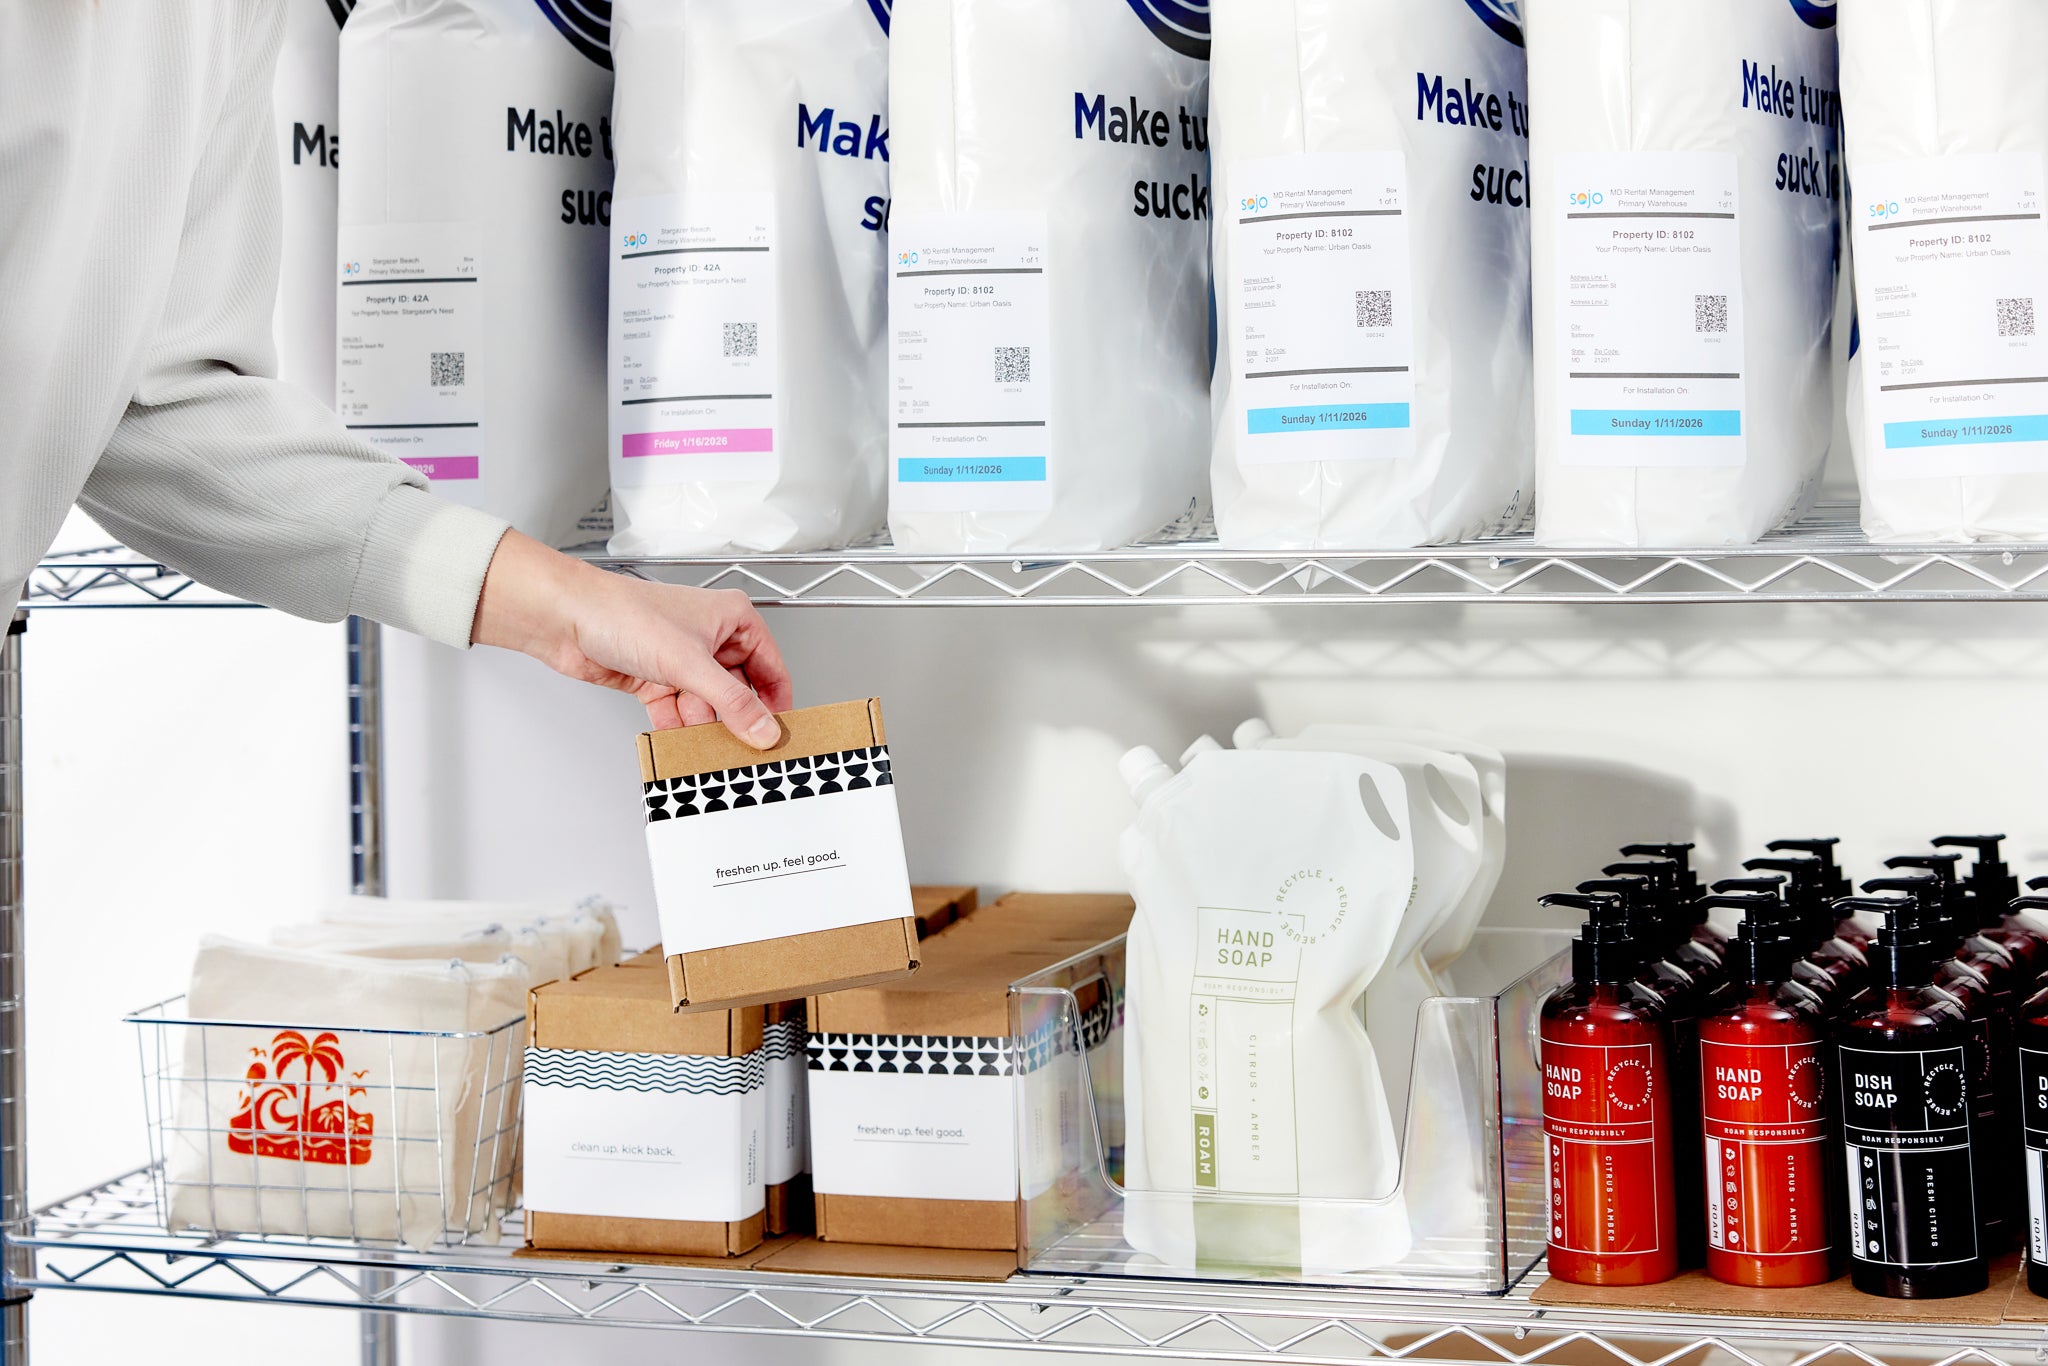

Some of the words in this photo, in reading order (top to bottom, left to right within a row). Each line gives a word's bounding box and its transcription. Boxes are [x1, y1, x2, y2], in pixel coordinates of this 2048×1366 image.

[1743, 59, 1794, 119] Make
[1417, 72, 1502, 131] Make
[1074, 92, 1169, 146] Make
[508, 107, 592, 155] Make
[1776, 147, 1821, 197] suck
[1134, 174, 1207, 220] suck
[1307, 188, 1352, 196] Management
[1570, 189, 1603, 208] sojo
[1650, 189, 1695, 198] Management
[1918, 194, 1939, 203] Rental
[1941, 192, 1989, 201] Management
[1241, 194, 1268, 213] sojo
[1280, 202, 1304, 210] Primary
[1305, 199, 1345, 208] Warehouse
[1870, 200, 1899, 219] sojo
[1913, 207, 1939, 215] Primary
[1940, 204, 1982, 212] Warehouse
[624, 231, 647, 249] sojo
[1277, 231, 1312, 240] Property
[1315, 230, 1328, 238] ID:
[1331, 229, 1353, 237] 8102
[1613, 230, 1653, 240] Property
[1656, 230, 1670, 239] ID:
[1673, 230, 1694, 239] 8102
[1910, 238, 1948, 248] Property
[1952, 236, 1965, 244] ID:
[1968, 234, 1991, 243] 8102
[1276, 245, 1302, 254] Property
[1304, 244, 1327, 252] Name:
[1613, 246, 1641, 254] Property
[1991, 249, 2010, 257] Oasis
[898, 249, 918, 268] sojo
[924, 288, 955, 296] Property
[973, 286, 994, 294] 8102
[1282, 415, 1315, 424] Sunday
[1319, 412, 1367, 422] 1/11/2026
[1612, 418, 1651, 429] Sunday
[1655, 419, 1703, 428] 1/11/2026
[1921, 428, 1958, 438] Sunday
[1962, 425, 2012, 436] 1/11/2026
[654, 439, 680, 449] Friday
[683, 437, 727, 447] 1/16/2026
[924, 466, 953, 475] Sunday
[957, 465, 1002, 474] 1/11/2026
[716, 863, 760, 878] freshen
[763, 862, 781, 871] up.
[783, 856, 805, 867] feel
[807, 849, 840, 865] good.
[1276, 869, 1322, 902] RECYCLE
[1330, 886, 1347, 932] REDUCE
[1218, 928, 1274, 948] HAND
[1280, 922, 1316, 944] REUSE
[1218, 948, 1272, 968] SOAP
[1249, 1034, 1258, 1088] CITRUS
[1788, 1057, 1816, 1080] RECYCLE
[1546, 1063, 1581, 1083] HAND
[1608, 1060, 1640, 1081] RECYCLE
[1716, 1066, 1761, 1084] HAND
[1924, 1064, 1954, 1087] RECYCLE
[1548, 1082, 1582, 1100] SOAP
[1642, 1070, 1653, 1104] REDUCE
[1855, 1074, 1892, 1090] DISH
[1608, 1092, 1634, 1110] REUSE
[1718, 1085, 1763, 1101] SOAP
[1789, 1090, 1812, 1108] REUSE
[1855, 1091, 1898, 1108] SOAP
[1926, 1098, 1950, 1116] REUSE
[858, 1125, 895, 1135] freshen
[898, 1126, 912, 1137] up.
[915, 1127, 933, 1137] feel
[936, 1128, 965, 1139] good.
[1251, 1112, 1259, 1162] AMBER
[1552, 1124, 1567, 1133] ROAM
[1570, 1127, 1625, 1136] RESPONSIBLY
[1724, 1128, 1745, 1136] ROAM
[571, 1142, 600, 1153] clean
[603, 1144, 619, 1155] up.
[622, 1144, 643, 1155] kick
[647, 1146, 674, 1157] back.
[1198, 1125, 1211, 1175] ROAM
[1926, 1168, 1935, 1202] FRESH
[1607, 1208, 1615, 1241] AMBER
[1789, 1208, 1798, 1242] AMBER
[1929, 1208, 1938, 1247] CITRUS
[2033, 1217, 2041, 1254] ROAM
